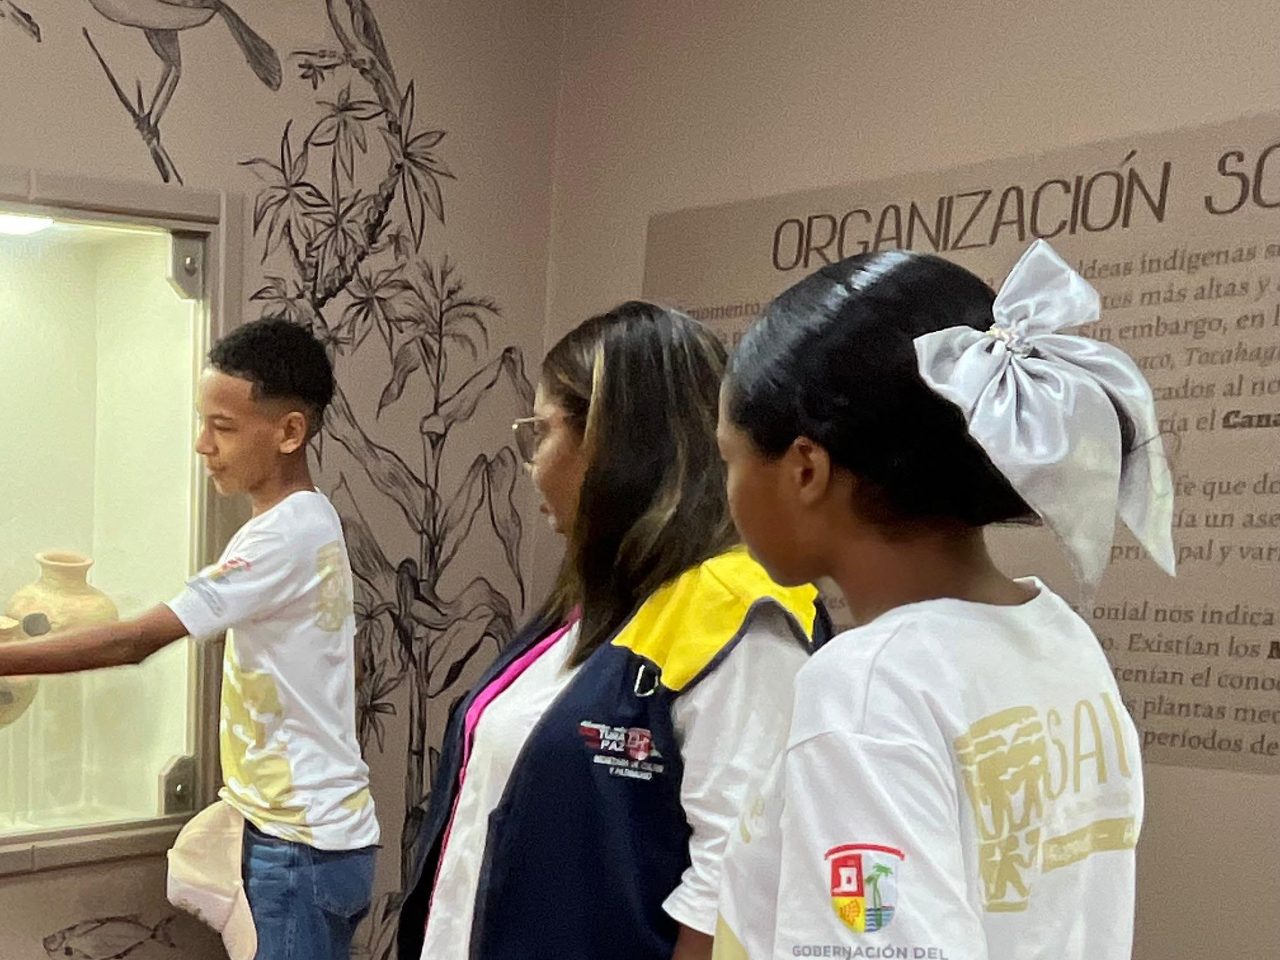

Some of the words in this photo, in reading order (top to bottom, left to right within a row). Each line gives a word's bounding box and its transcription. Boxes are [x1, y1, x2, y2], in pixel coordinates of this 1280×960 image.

[771, 149, 1172, 272] ORGANIZACIÓN
[1078, 258, 1134, 279] ldeas
[1193, 277, 1250, 301] altas
[1118, 315, 1228, 340] embargo,
[1235, 311, 1265, 331] en
[1222, 373, 1244, 398] al
[1195, 408, 1217, 431] el
[1222, 410, 1280, 429] Cana
[1201, 479, 1248, 501] que
[1092, 601, 1149, 622] onial
[1154, 606, 1194, 624] nos
[1228, 635, 1262, 658] los
[1191, 666, 1212, 688] el
[1142, 695, 1227, 721] plantas
[792, 943, 909, 960] GOBERNACIÓN
[912, 946, 949, 960] DEL
